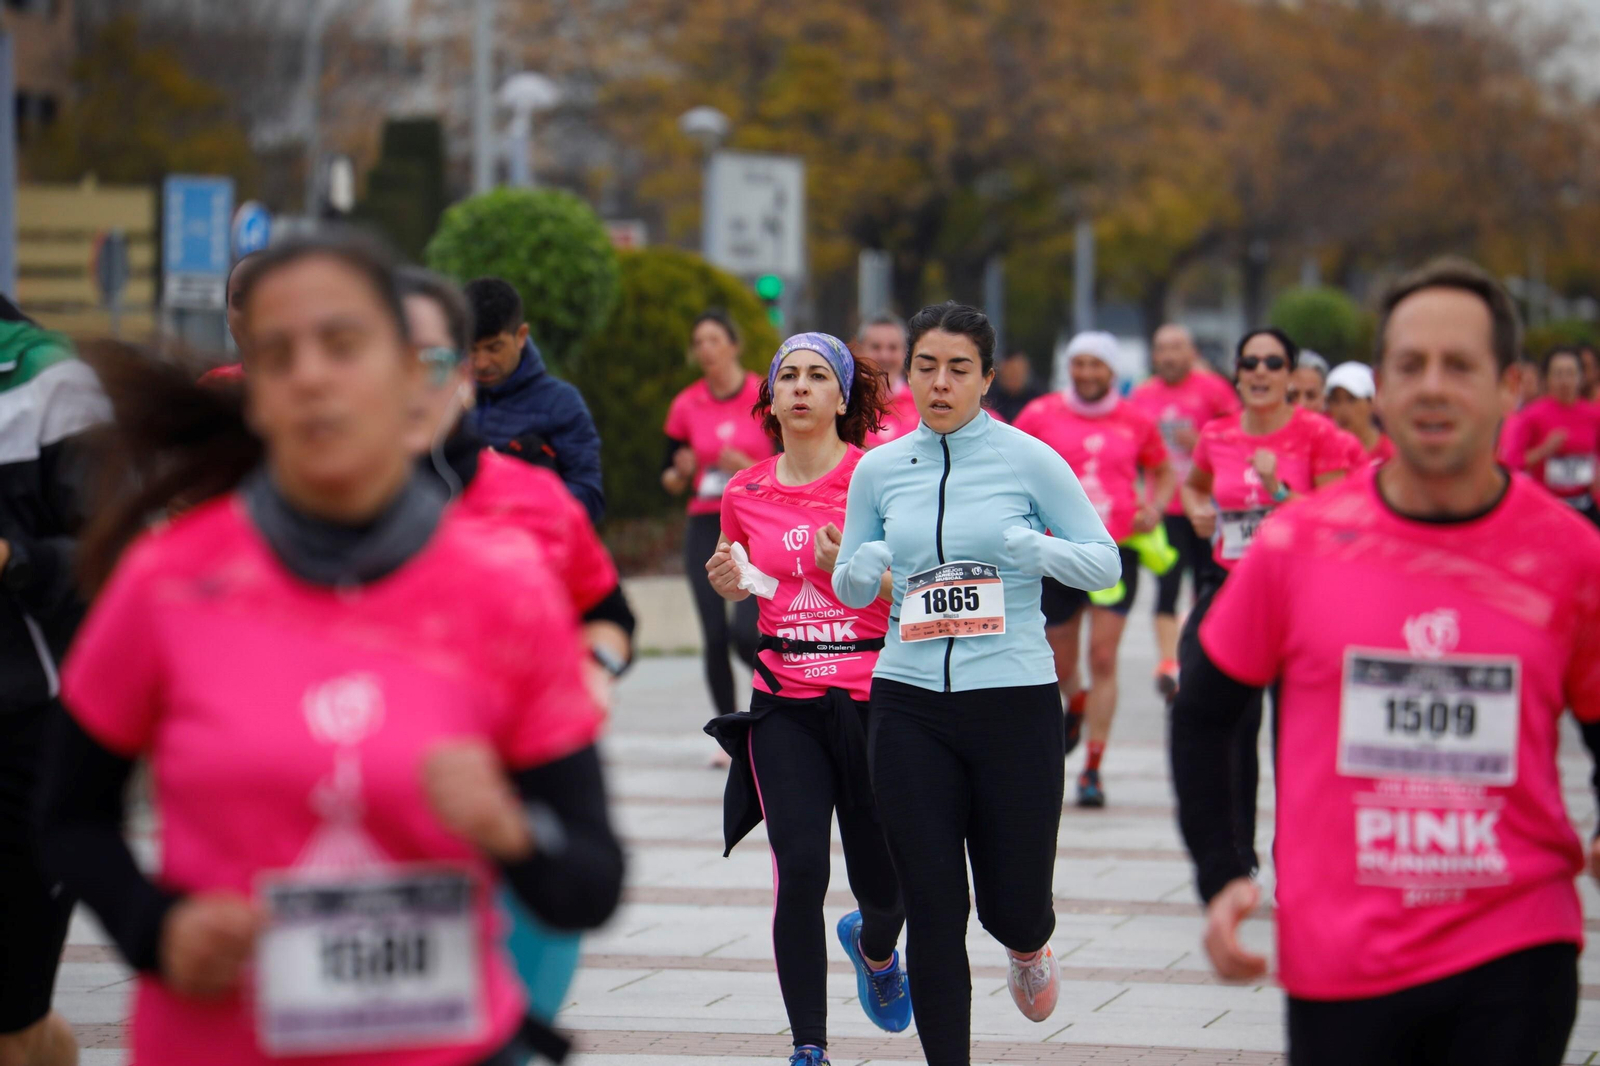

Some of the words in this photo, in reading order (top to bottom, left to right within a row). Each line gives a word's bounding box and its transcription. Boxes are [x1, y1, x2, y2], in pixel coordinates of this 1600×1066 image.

[921, 586, 979, 614] 1865
[782, 614, 797, 622] VIII
[800, 608, 844, 620] EDICIÓN
[776, 621, 858, 642] PINK
[828, 644, 856, 652] Kalenji
[804, 665, 837, 678] 2023
[1384, 697, 1477, 737] 1509
[1356, 809, 1499, 852] PINK
